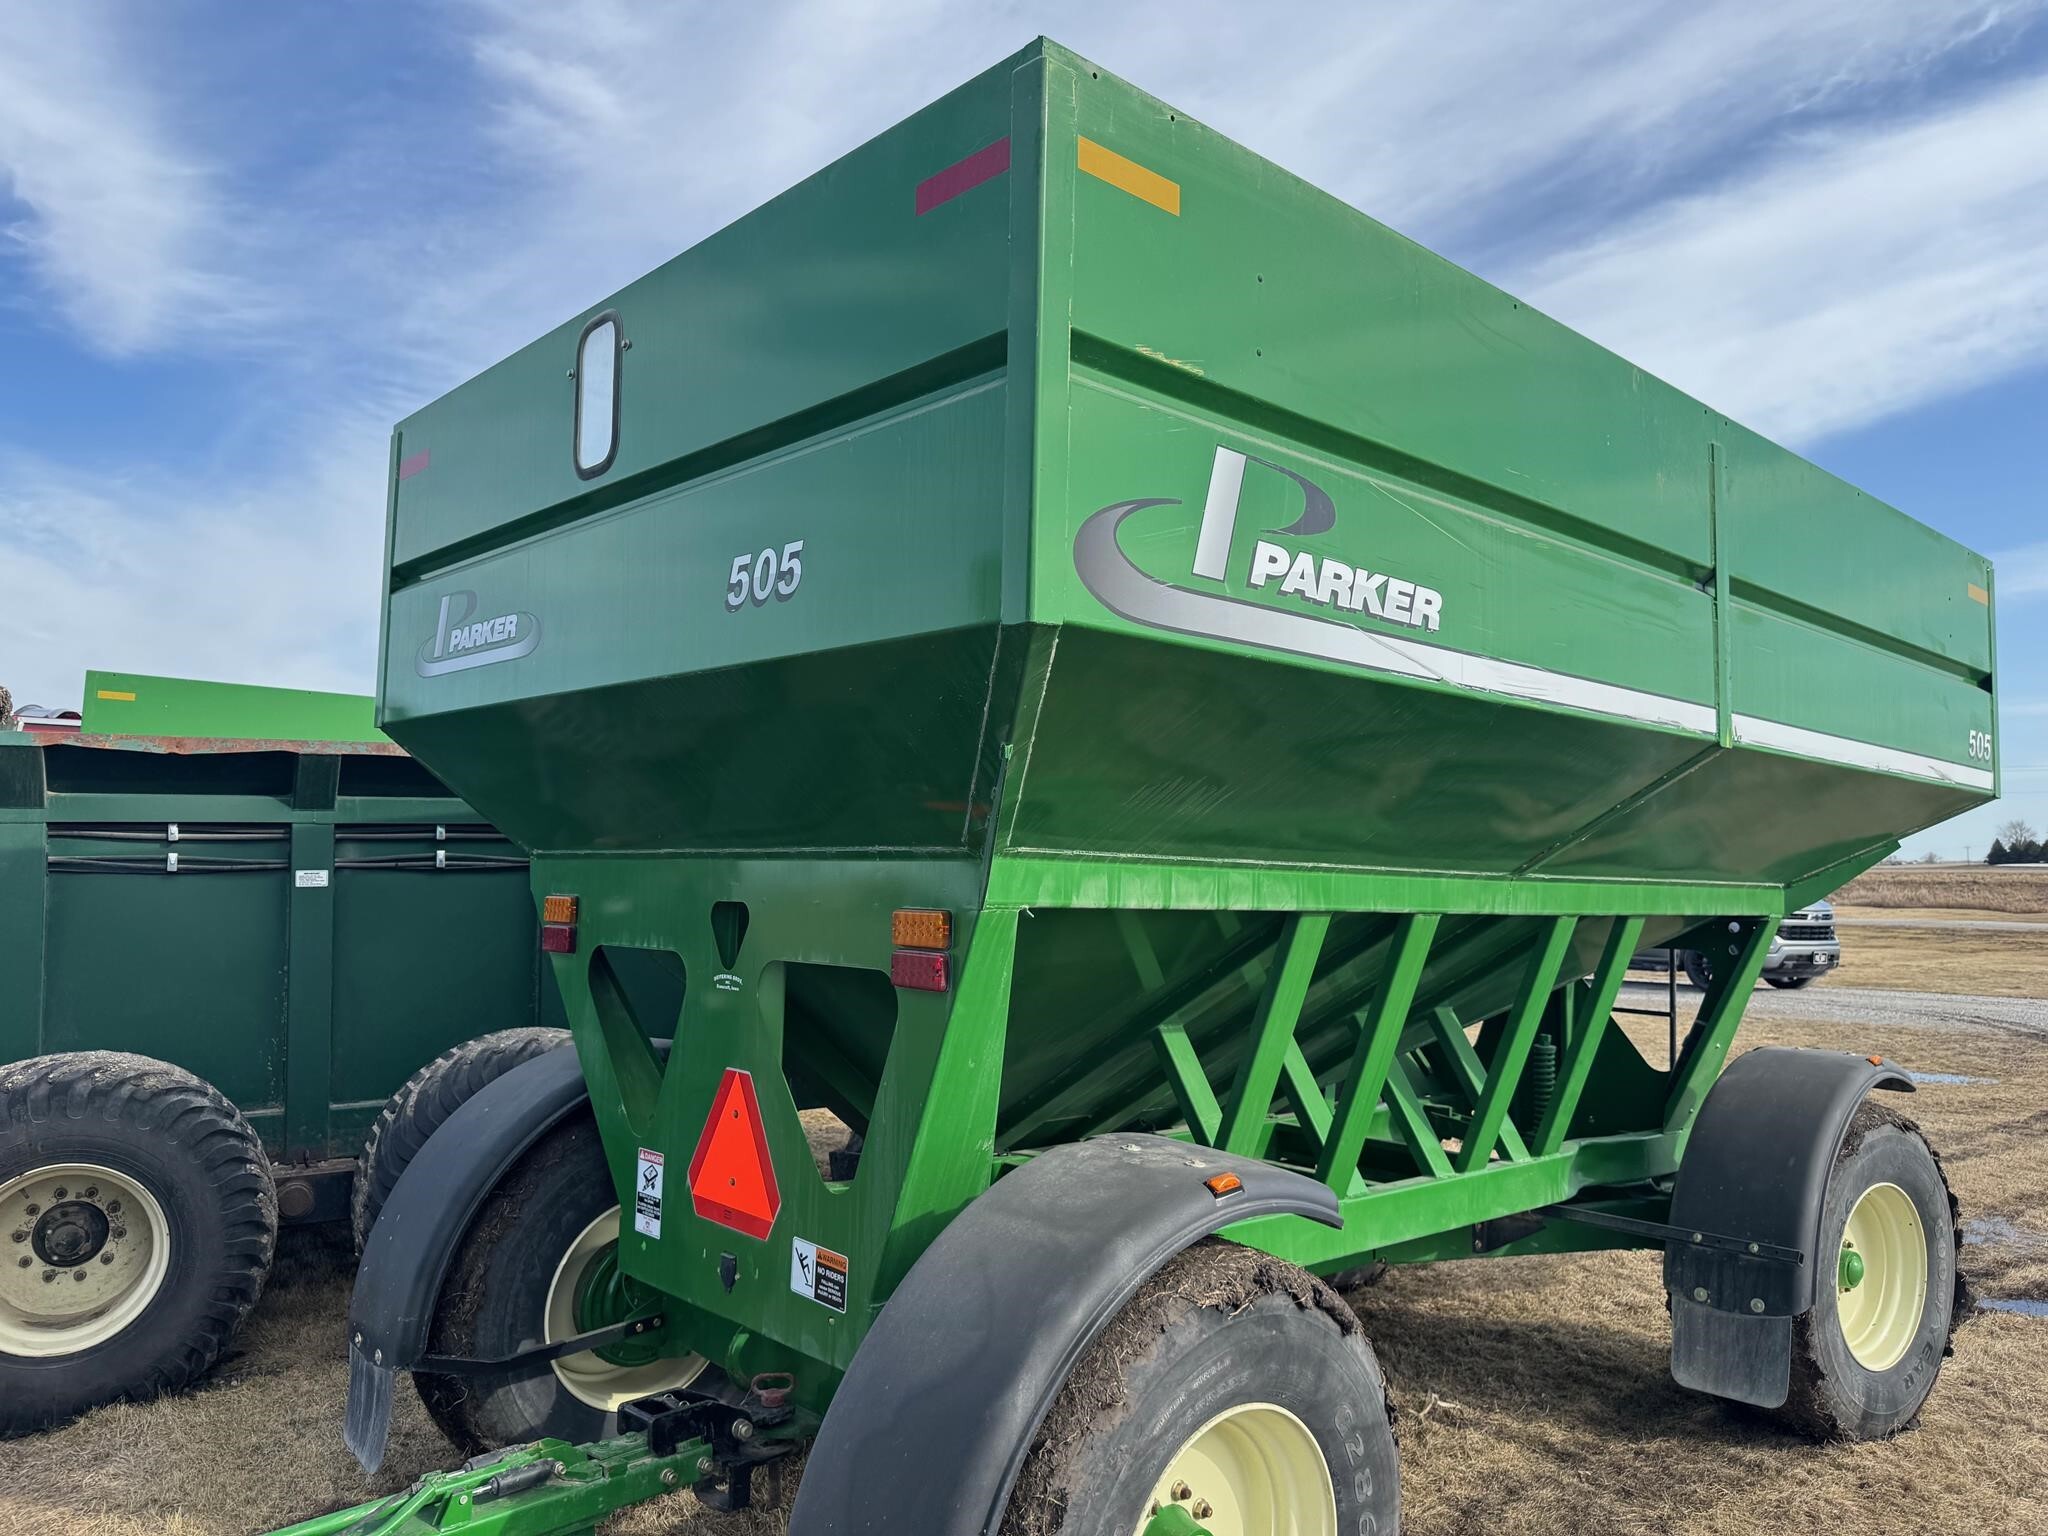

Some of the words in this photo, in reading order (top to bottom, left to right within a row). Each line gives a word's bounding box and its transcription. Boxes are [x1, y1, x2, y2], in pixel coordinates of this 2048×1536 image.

[725, 540, 804, 613] 505
[1247, 540, 1443, 632] PARKER
[449, 614, 518, 653] PARKER
[1968, 729, 1991, 762] 505
[644, 1152, 664, 1165] DANGER
[817, 1265, 826, 1276] NO
[825, 1269, 845, 1284] RIDERS
[821, 1253, 847, 1270] WARNING
